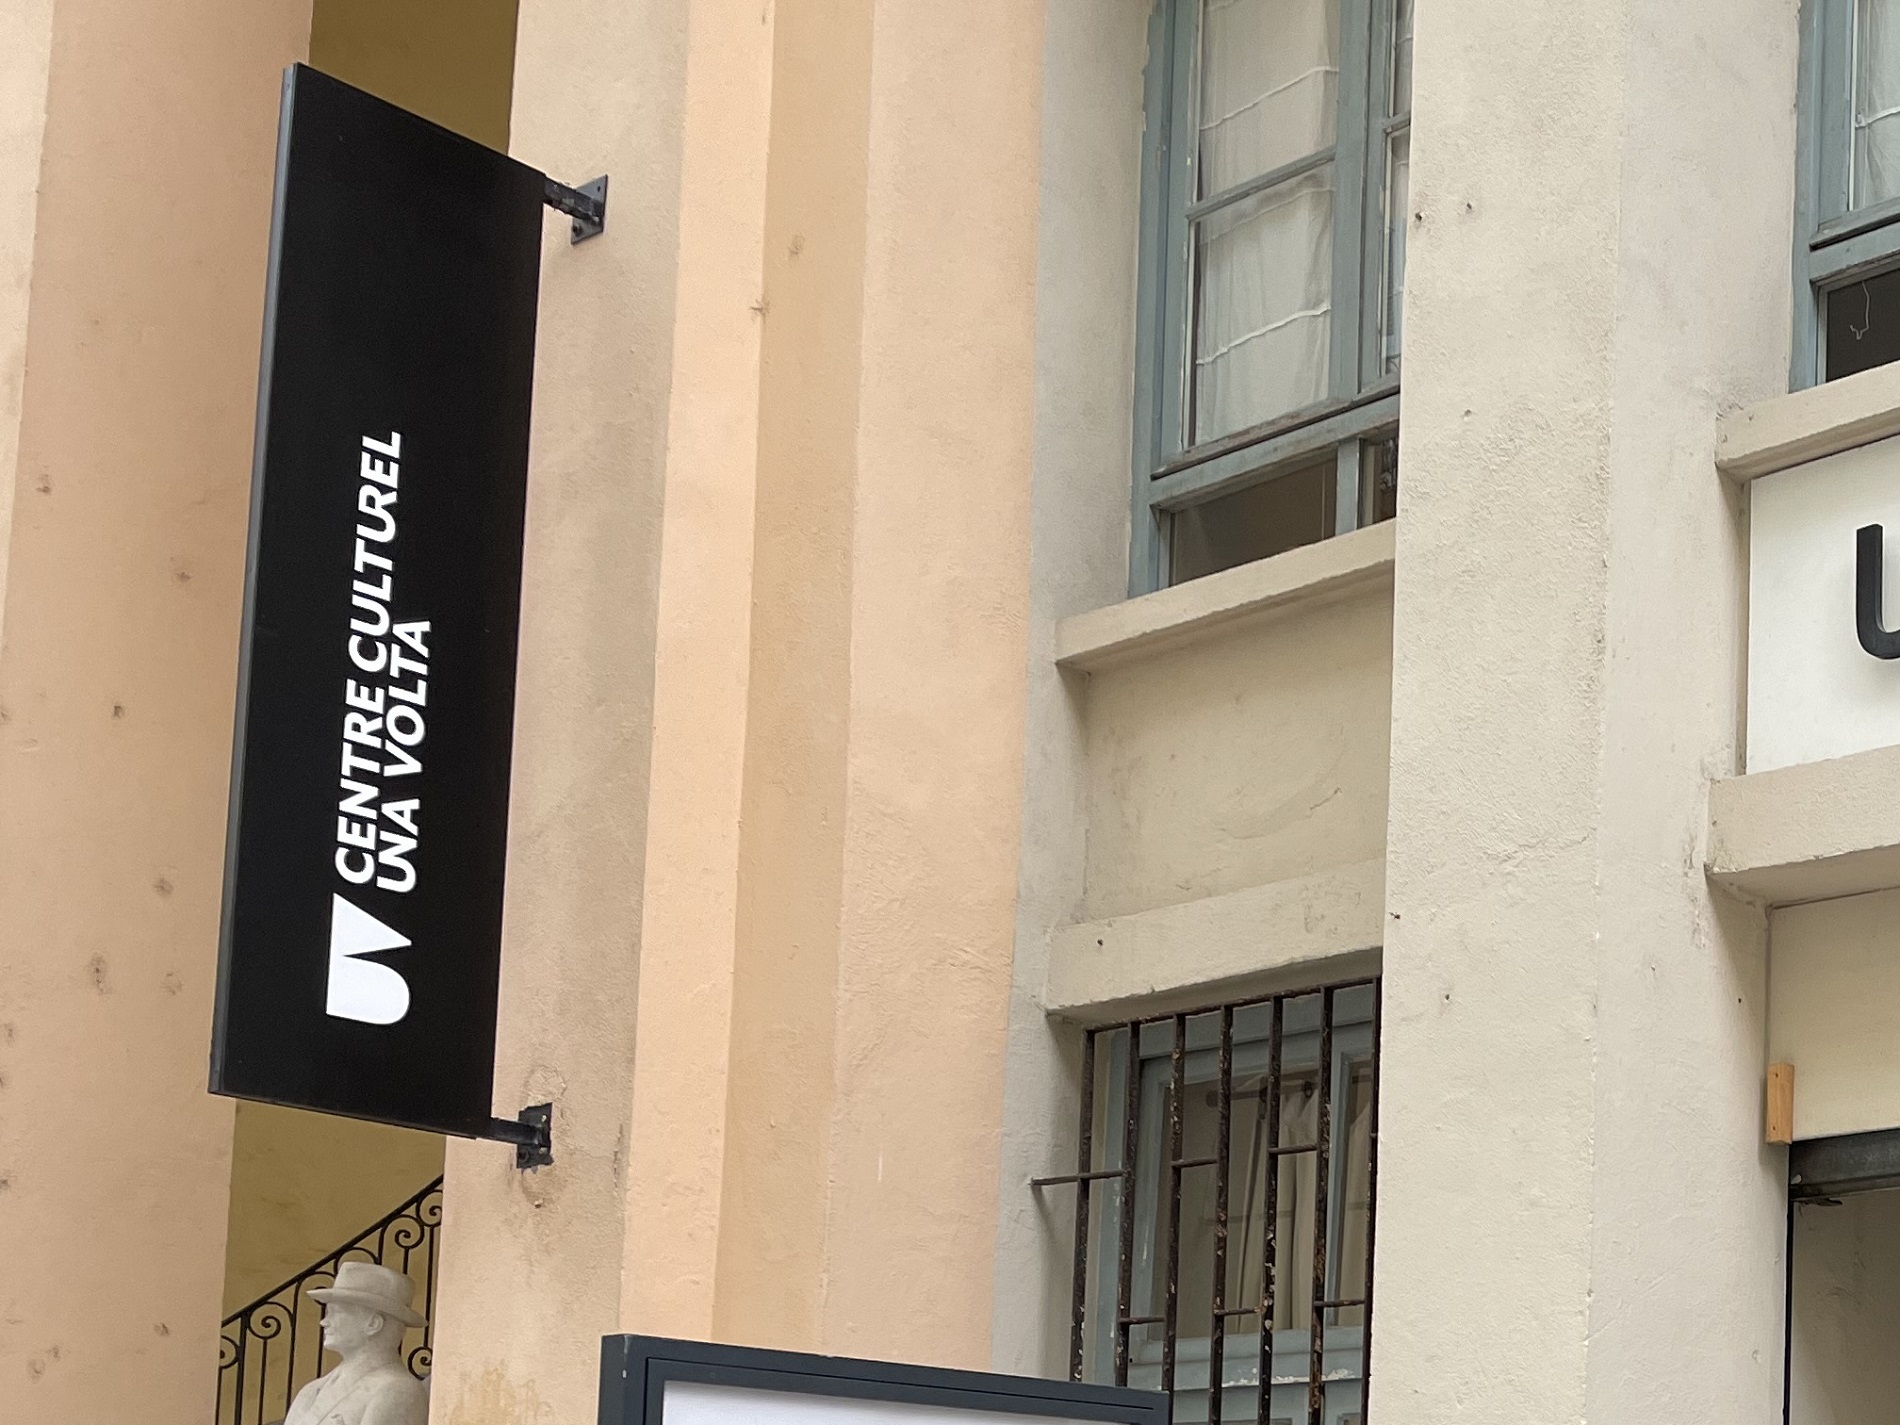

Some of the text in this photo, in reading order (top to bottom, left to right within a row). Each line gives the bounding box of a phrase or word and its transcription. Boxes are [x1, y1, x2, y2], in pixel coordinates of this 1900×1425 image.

[334, 431, 402, 885] CENTRE CULTUREL
[376, 619, 431, 893] UNA VOLTA
